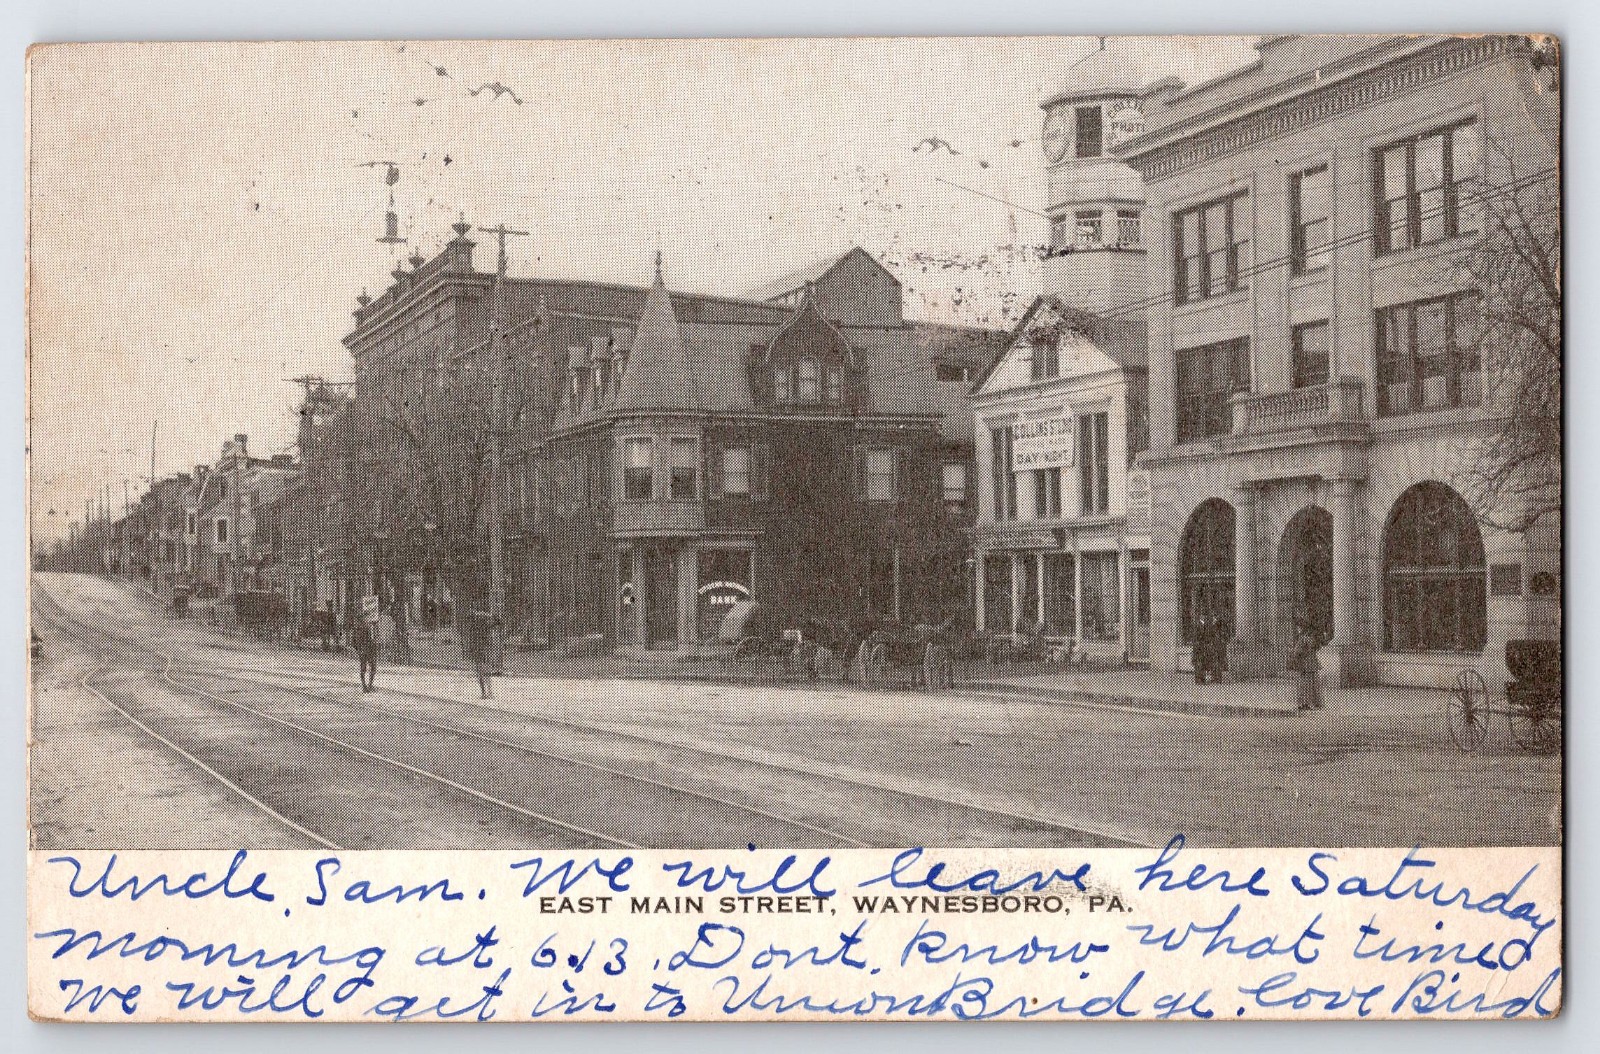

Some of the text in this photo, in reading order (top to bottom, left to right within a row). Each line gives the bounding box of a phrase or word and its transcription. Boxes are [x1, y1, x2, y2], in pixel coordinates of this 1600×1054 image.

[710, 595, 738, 605] BANK
[662, 842, 836, 898] will
[858, 845, 1091, 896] leave
[1135, 833, 1270, 896] here
[1291, 841, 1556, 971] Saturday
[900, 919, 1110, 967] know
[166, 973, 329, 1018] will
